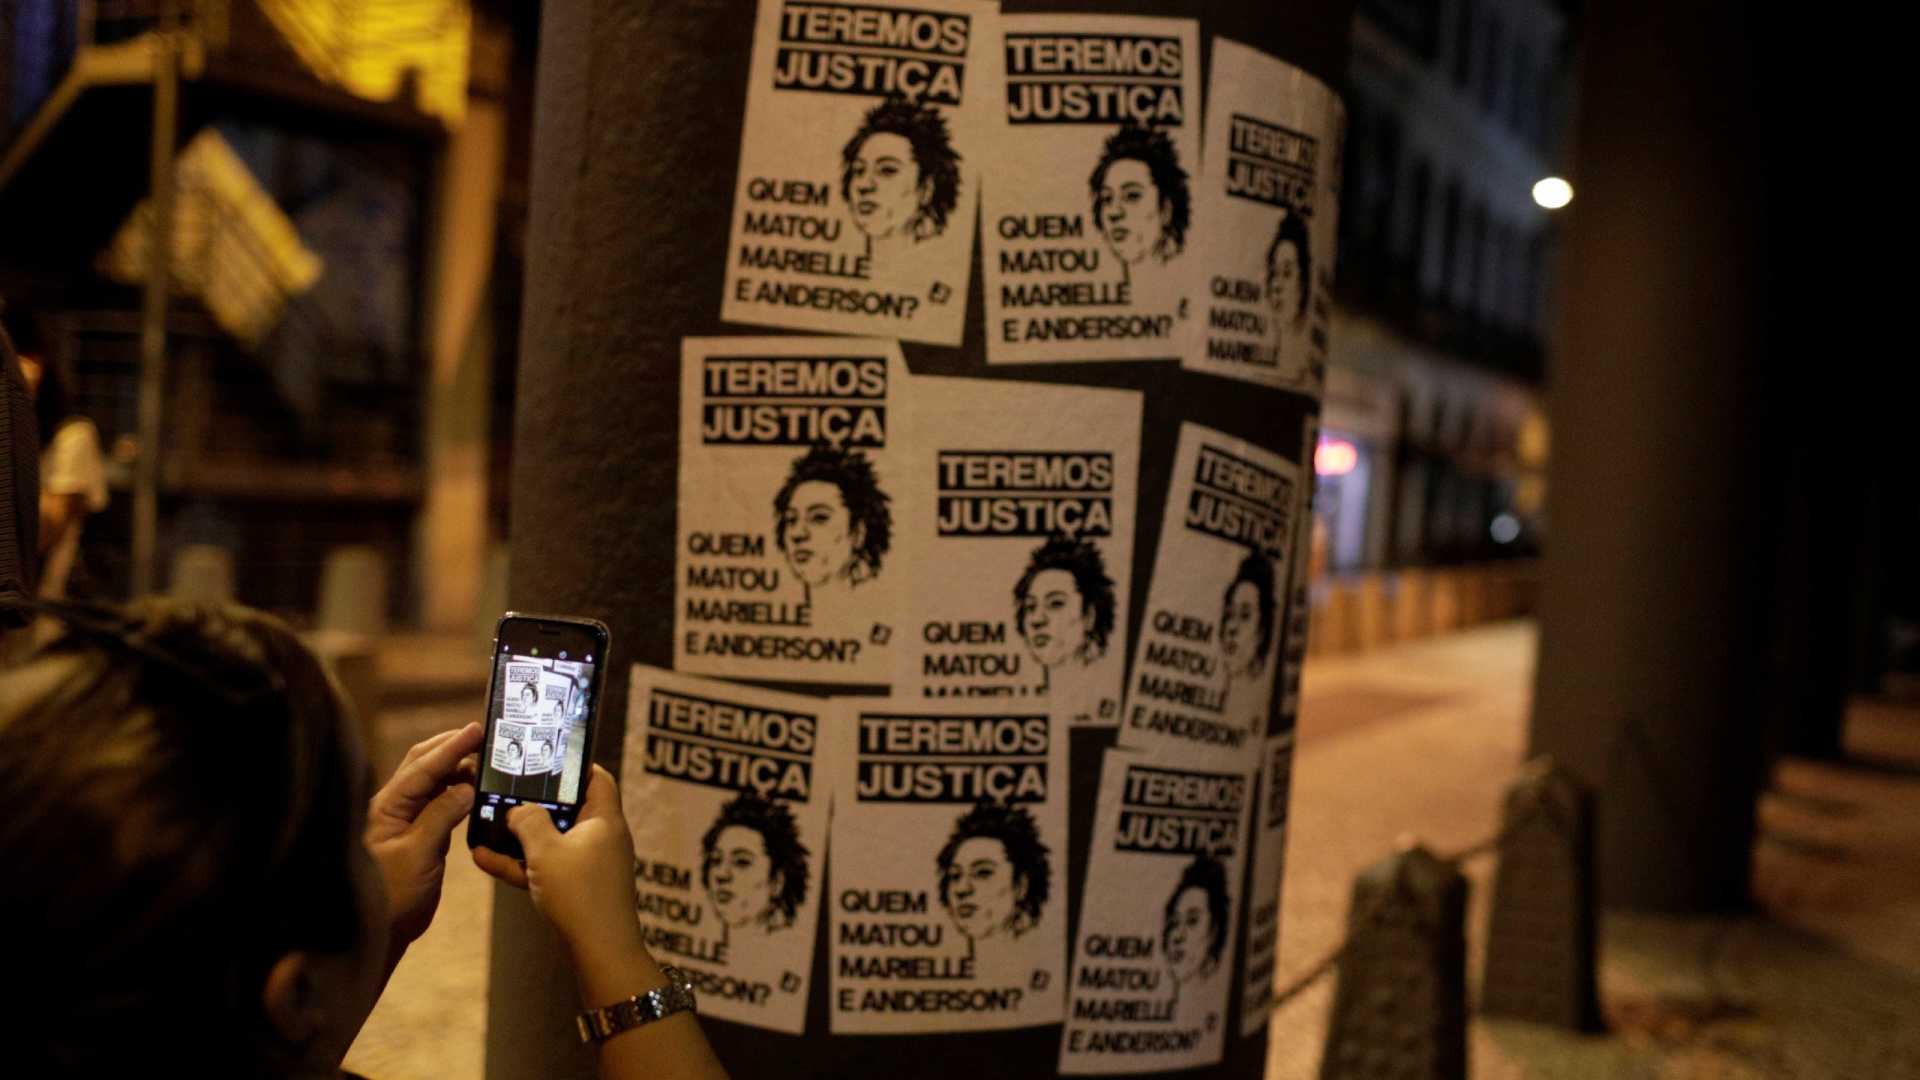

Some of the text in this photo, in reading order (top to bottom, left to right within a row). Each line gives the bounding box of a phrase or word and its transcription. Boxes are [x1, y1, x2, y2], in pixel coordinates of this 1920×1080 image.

[783, 5, 968, 54] TEREMOS
[1007, 38, 1182, 75] TEREMOS
[776, 50, 962, 100] JUSTIÇA
[1008, 83, 1183, 122] JUSTIÇA
[748, 177, 830, 206] QUEM
[743, 212, 841, 242] MATOU
[999, 216, 1083, 240] QUEM
[738, 245, 871, 280] MARIELLE
[999, 250, 1099, 274] MATOU
[735, 278, 919, 320] E ANDERSON?
[1001, 282, 1132, 308] MARIELLE
[1003, 314, 1173, 343] E ANDERSON?
[704, 360, 887, 396] TEREMOS
[704, 406, 884, 446] JUSTIÇA
[940, 455, 1112, 490] TEREMOS
[938, 499, 1110, 538] JUSTIÇA
[687, 532, 765, 558] QUEM
[686, 566, 779, 593] MATOU
[685, 598, 813, 628] MARIELLE
[685, 632, 861, 664] E ANDERSON?
[923, 621, 1005, 645] QUEM
[922, 653, 1020, 677] MATOU
[650, 691, 815, 752] TEREMOS
[861, 718, 1048, 754] TEREMOS
[645, 740, 809, 801] JUSTIÇA
[858, 764, 1046, 803] JUSTIÇA
[840, 889, 928, 914] QUEM
[839, 923, 943, 948] MATOU
[1085, 934, 1154, 959] QUEM
[838, 956, 976, 981] MARIELLE
[1078, 965, 1161, 991] MATOU
[838, 988, 1024, 1013] E ANDERSON?
[1068, 1030, 1086, 1053] E
